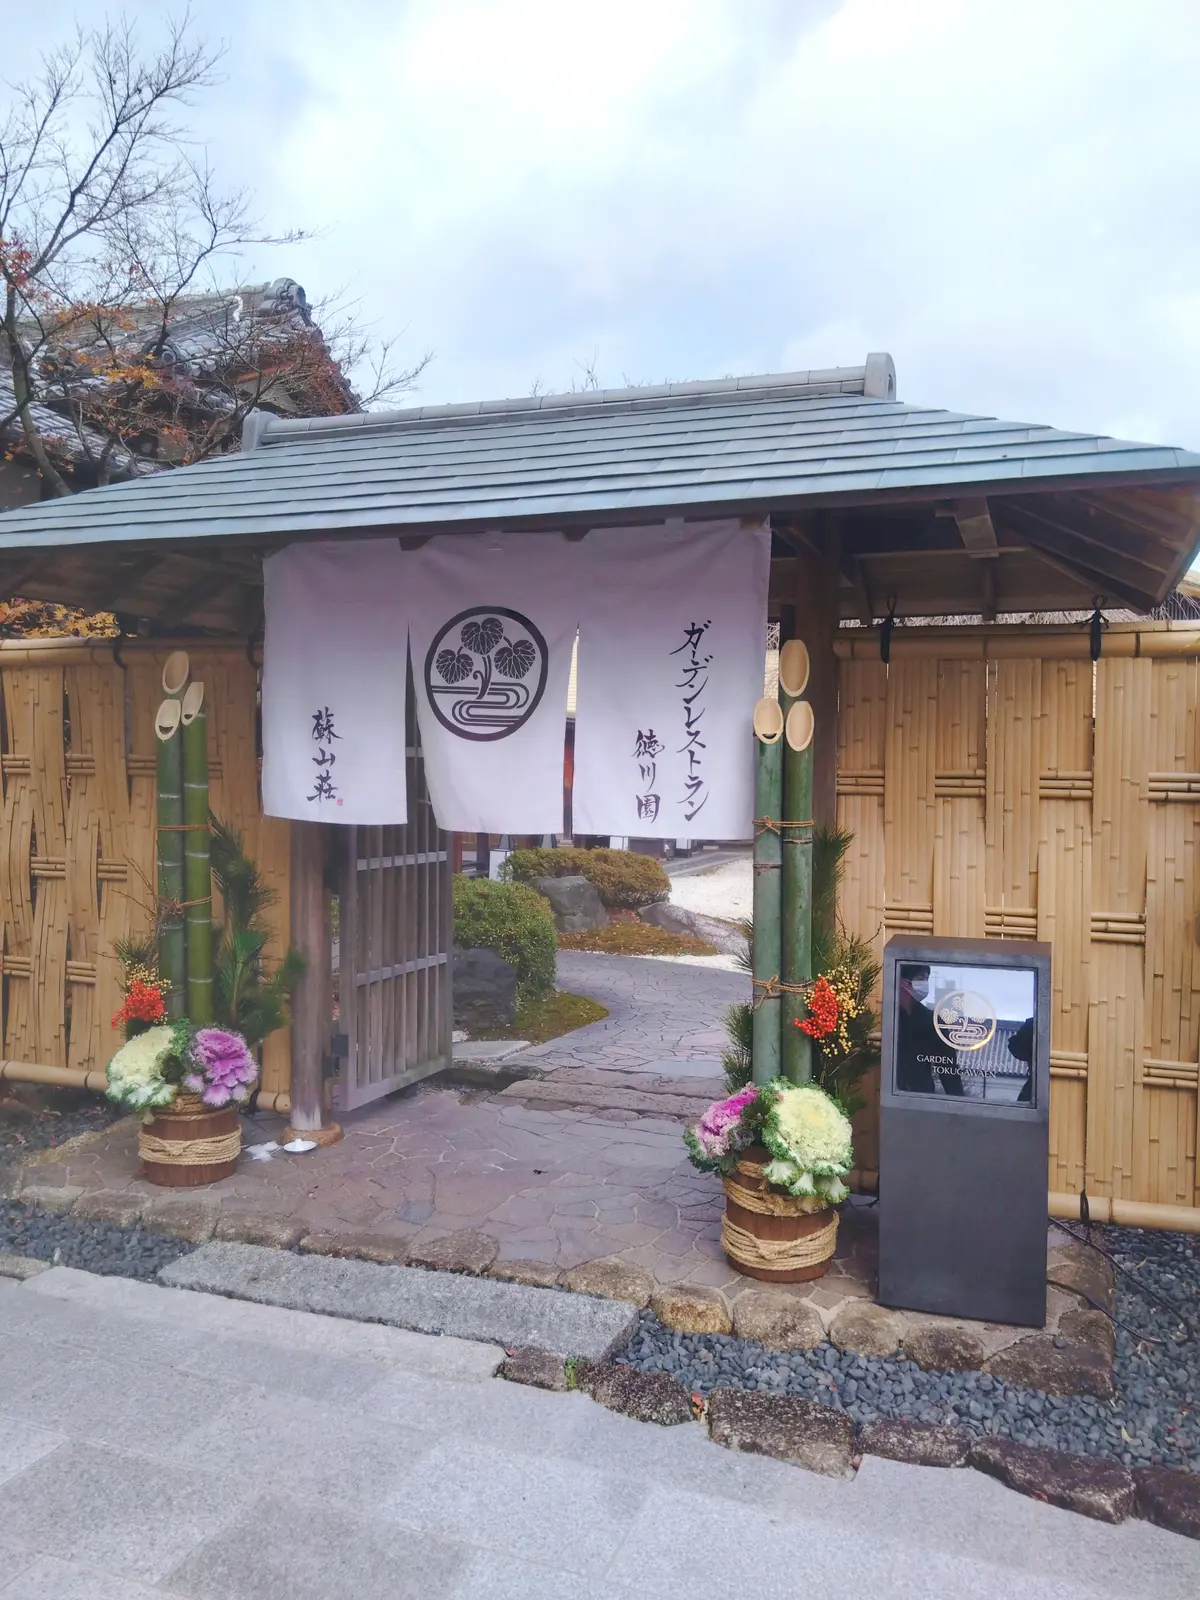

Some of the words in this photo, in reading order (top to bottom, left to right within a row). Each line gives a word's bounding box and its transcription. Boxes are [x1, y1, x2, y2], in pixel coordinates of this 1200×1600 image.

[306, 706, 343, 803] 蘇山荘
[669, 620, 713, 822] ガーデンレストラン
[631, 729, 665, 823] 徳川園
[916, 1054, 954, 1064] GARDEN
[932, 1066, 997, 1078] TOKUGAWAEN
